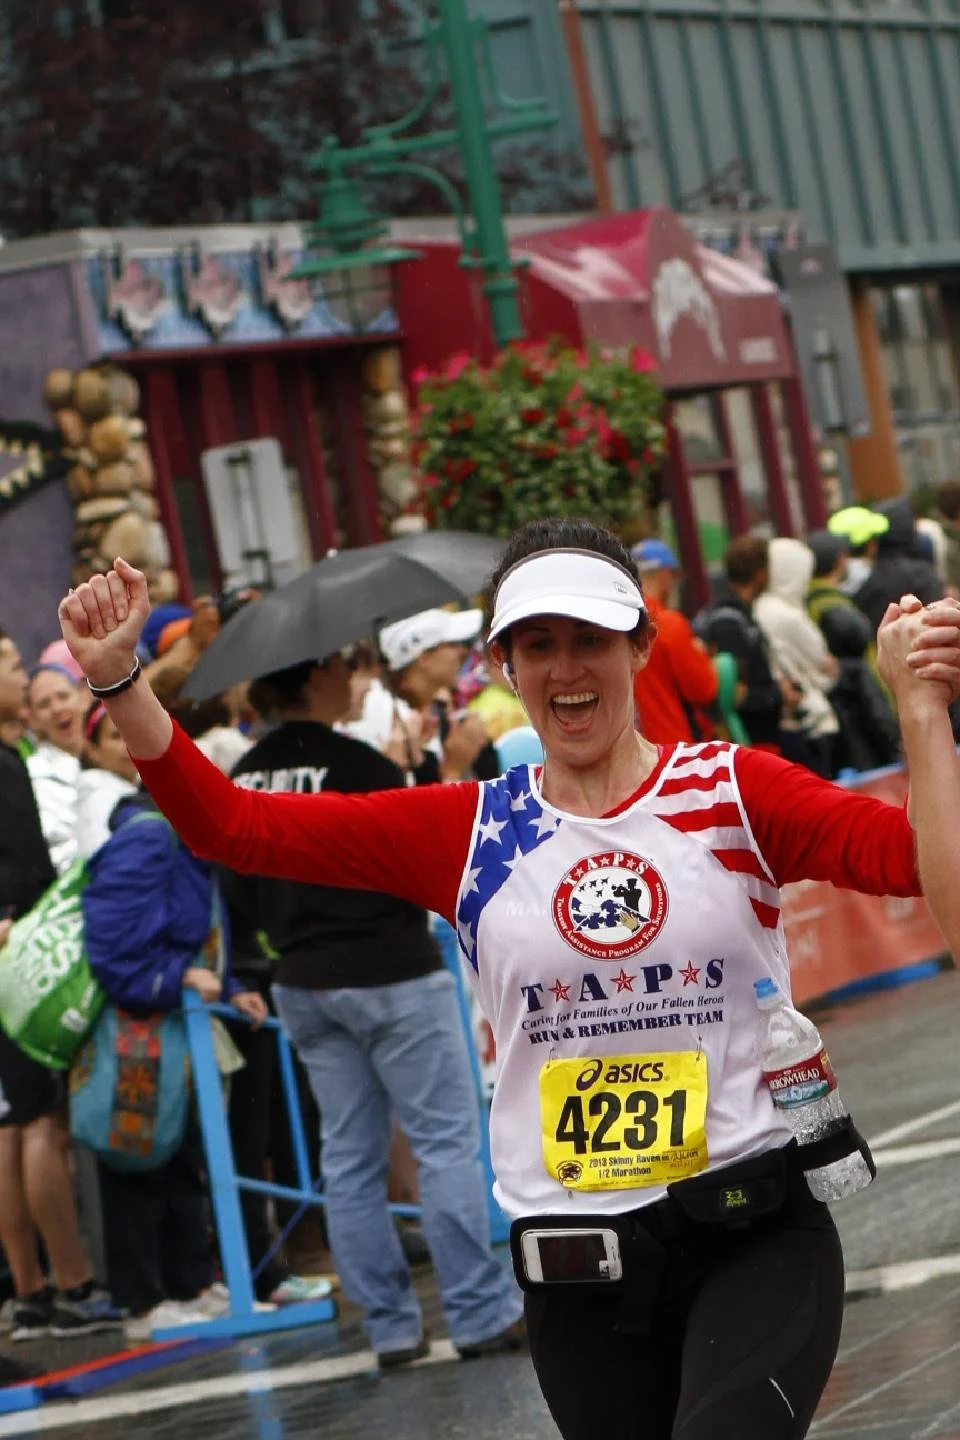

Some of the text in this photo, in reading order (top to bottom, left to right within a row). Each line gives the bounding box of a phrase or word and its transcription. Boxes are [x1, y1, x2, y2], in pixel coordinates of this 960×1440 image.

[608, 940, 645, 958] PROGRAM
[556, 1013, 572, 1026] for
[573, 1006, 618, 1021] Families
[621, 1003, 634, 1015] of
[636, 1000, 657, 1012] Our
[661, 997, 694, 1010] Fallen
[528, 1010, 724, 1044] RUN & REMEMBER TEAM
[556, 1089, 687, 1155] 4231
[589, 1157, 607, 1168] 2013
[608, 1154, 634, 1168] Skinny
[637, 1154, 662, 1164] Raven
[598, 1166, 651, 1179] 1/2 Marathon
